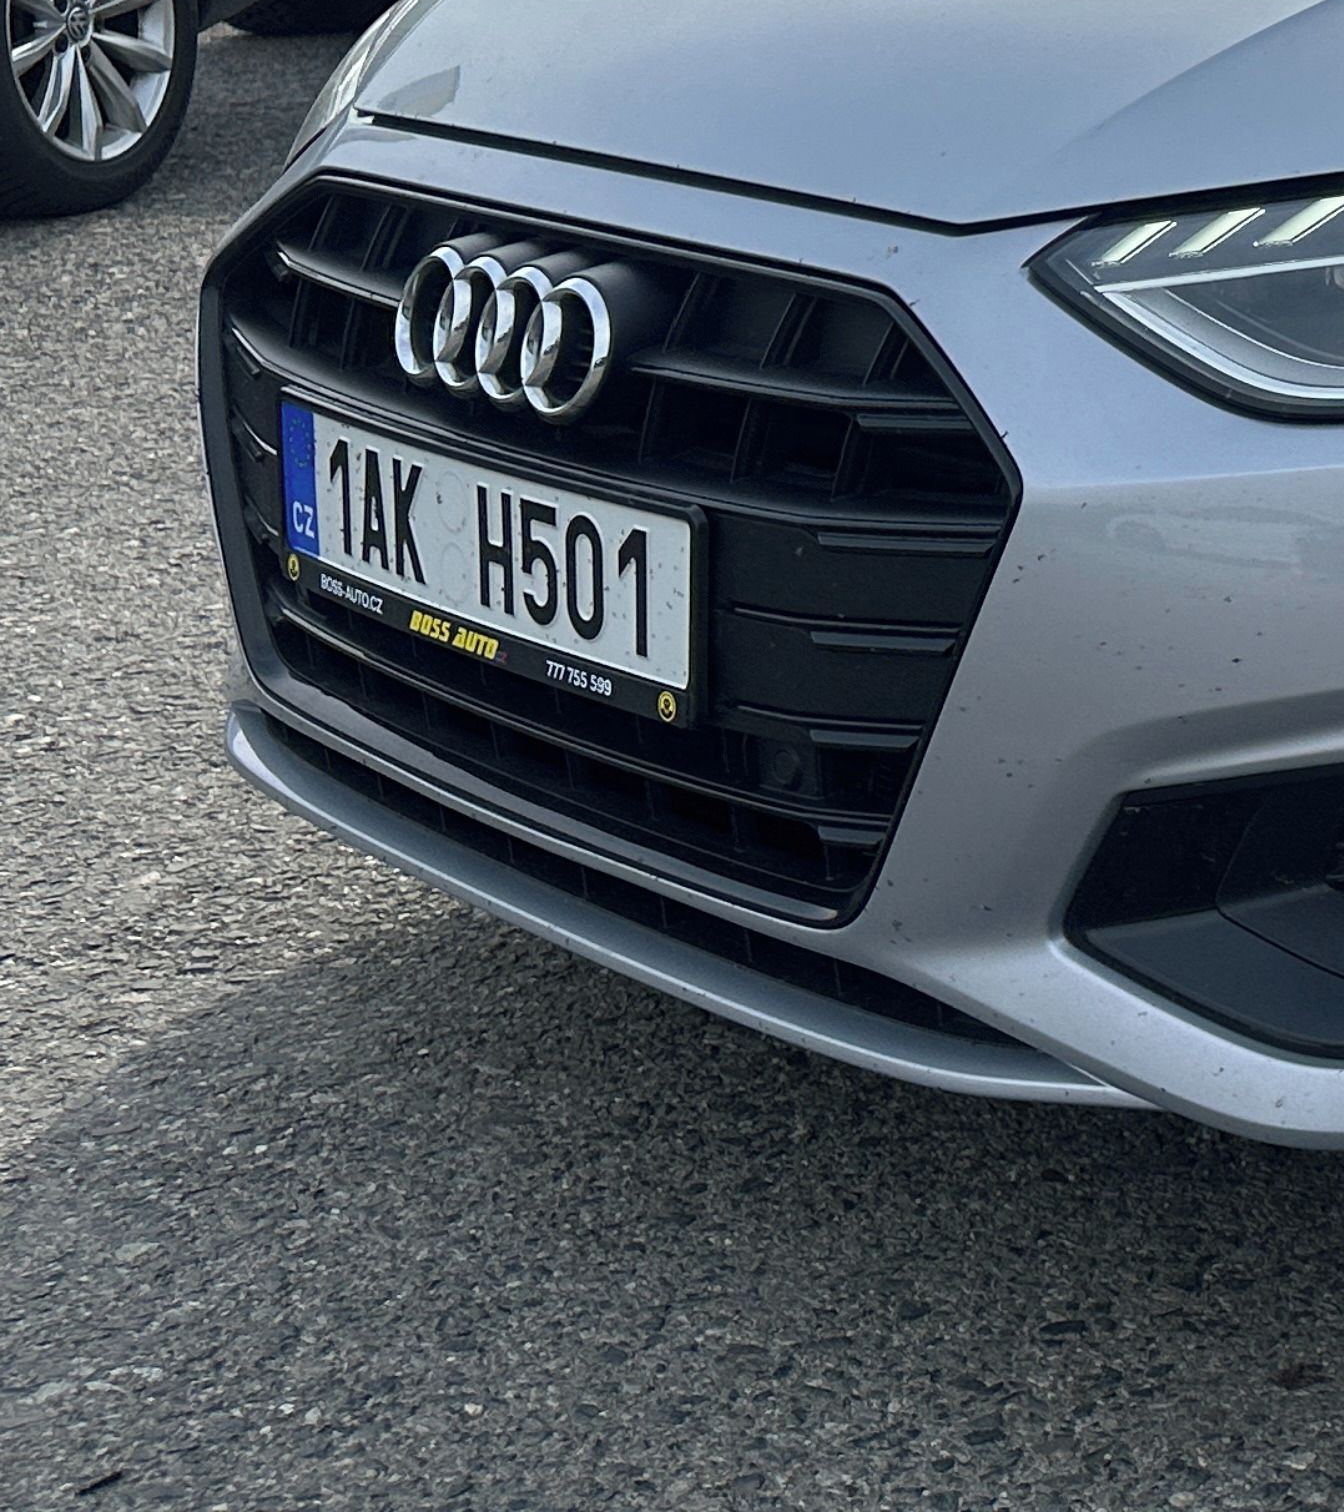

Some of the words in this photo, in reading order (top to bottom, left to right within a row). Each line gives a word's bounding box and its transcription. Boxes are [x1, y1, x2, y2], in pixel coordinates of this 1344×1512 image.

[293, 500, 315, 539] CZ
[329, 438, 427, 585] 1AK
[476, 484, 649, 658] H501
[319, 572, 384, 615] BOSS-AUTO.CZ
[409, 609, 451, 643] BOSS
[452, 626, 500, 661] AUTO
[545, 659, 565, 681] 777
[567, 666, 588, 689] 755
[590, 674, 613, 697] 599
